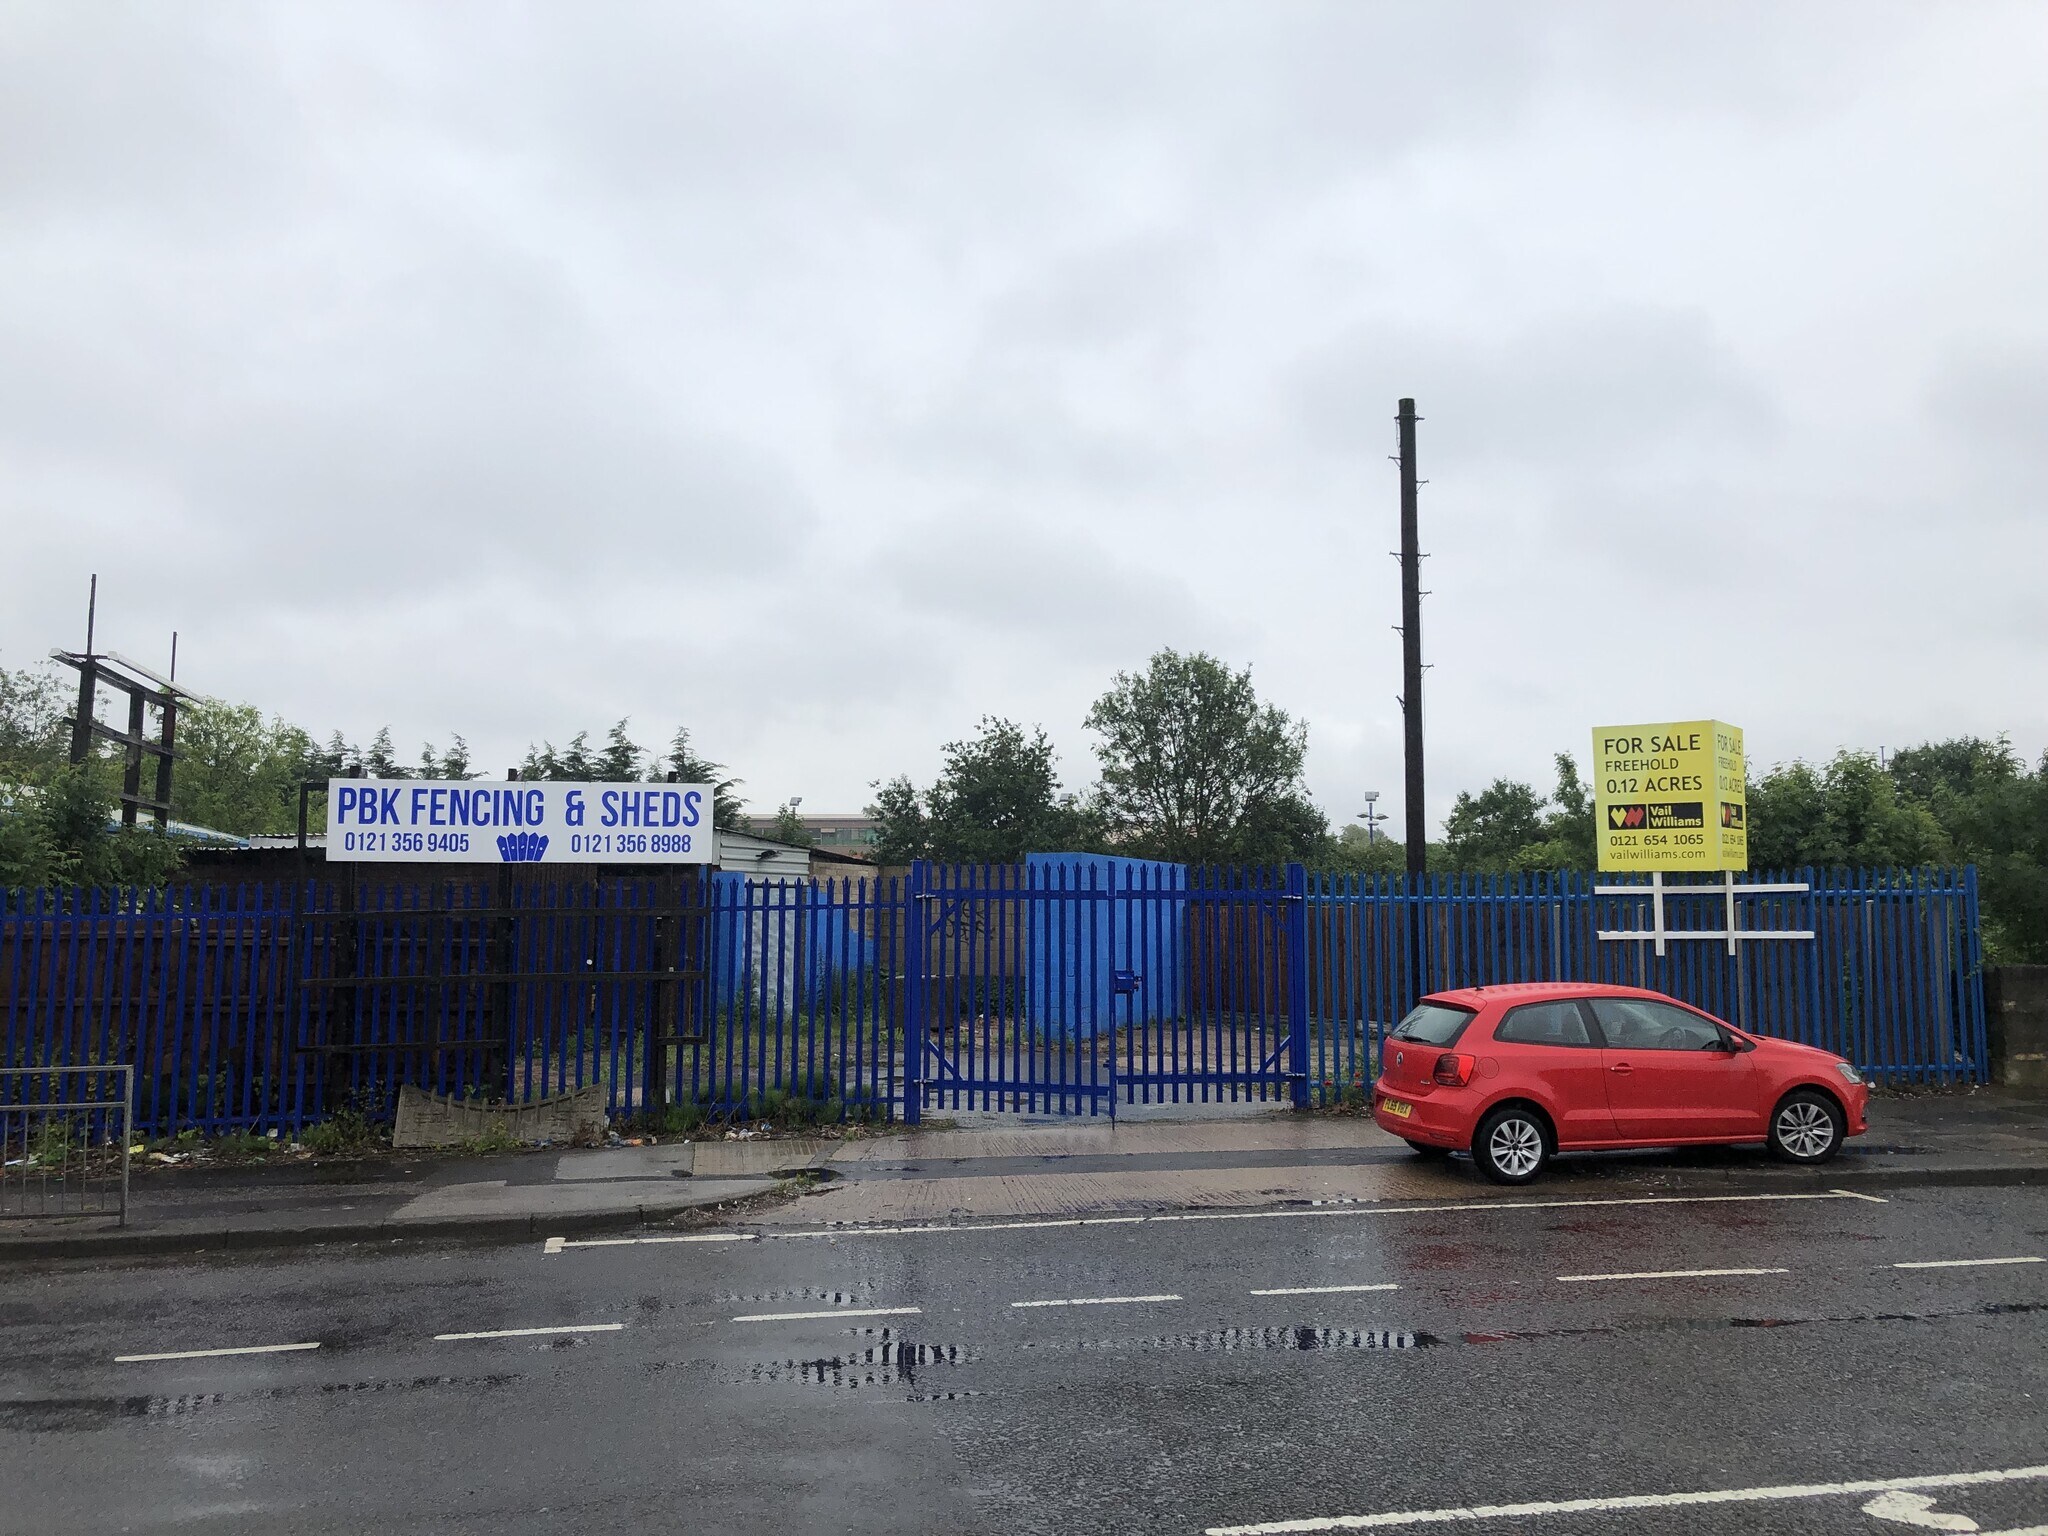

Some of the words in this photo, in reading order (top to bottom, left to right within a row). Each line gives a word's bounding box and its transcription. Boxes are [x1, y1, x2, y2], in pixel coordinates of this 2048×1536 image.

[1604, 737, 1643, 755] FOR
[1651, 734, 1701, 753] SALE
[1605, 757, 1679, 772] FREEHOLD
[1606, 778, 1639, 794] 0.12
[1645, 775, 1702, 792] ACRES
[337, 787, 400, 825] PBK
[410, 788, 544, 826] FENCING
[565, 790, 586, 827] &
[600, 790, 702, 827] SHEDS
[1650, 805, 1672, 817] Vail
[1651, 816, 1702, 828] Williams
[344, 831, 387, 852] 0121
[391, 832, 424, 852] 356
[427, 832, 470, 853] 9405
[571, 834, 612, 854] 0121
[616, 834, 648, 853] 356
[650, 834, 692, 854] 8988
[1610, 835, 1638, 846] 0121
[1644, 834, 1668, 845] 654
[1674, 834, 1704, 845] 1065
[1610, 848, 1706, 860] vailwilliams.com
